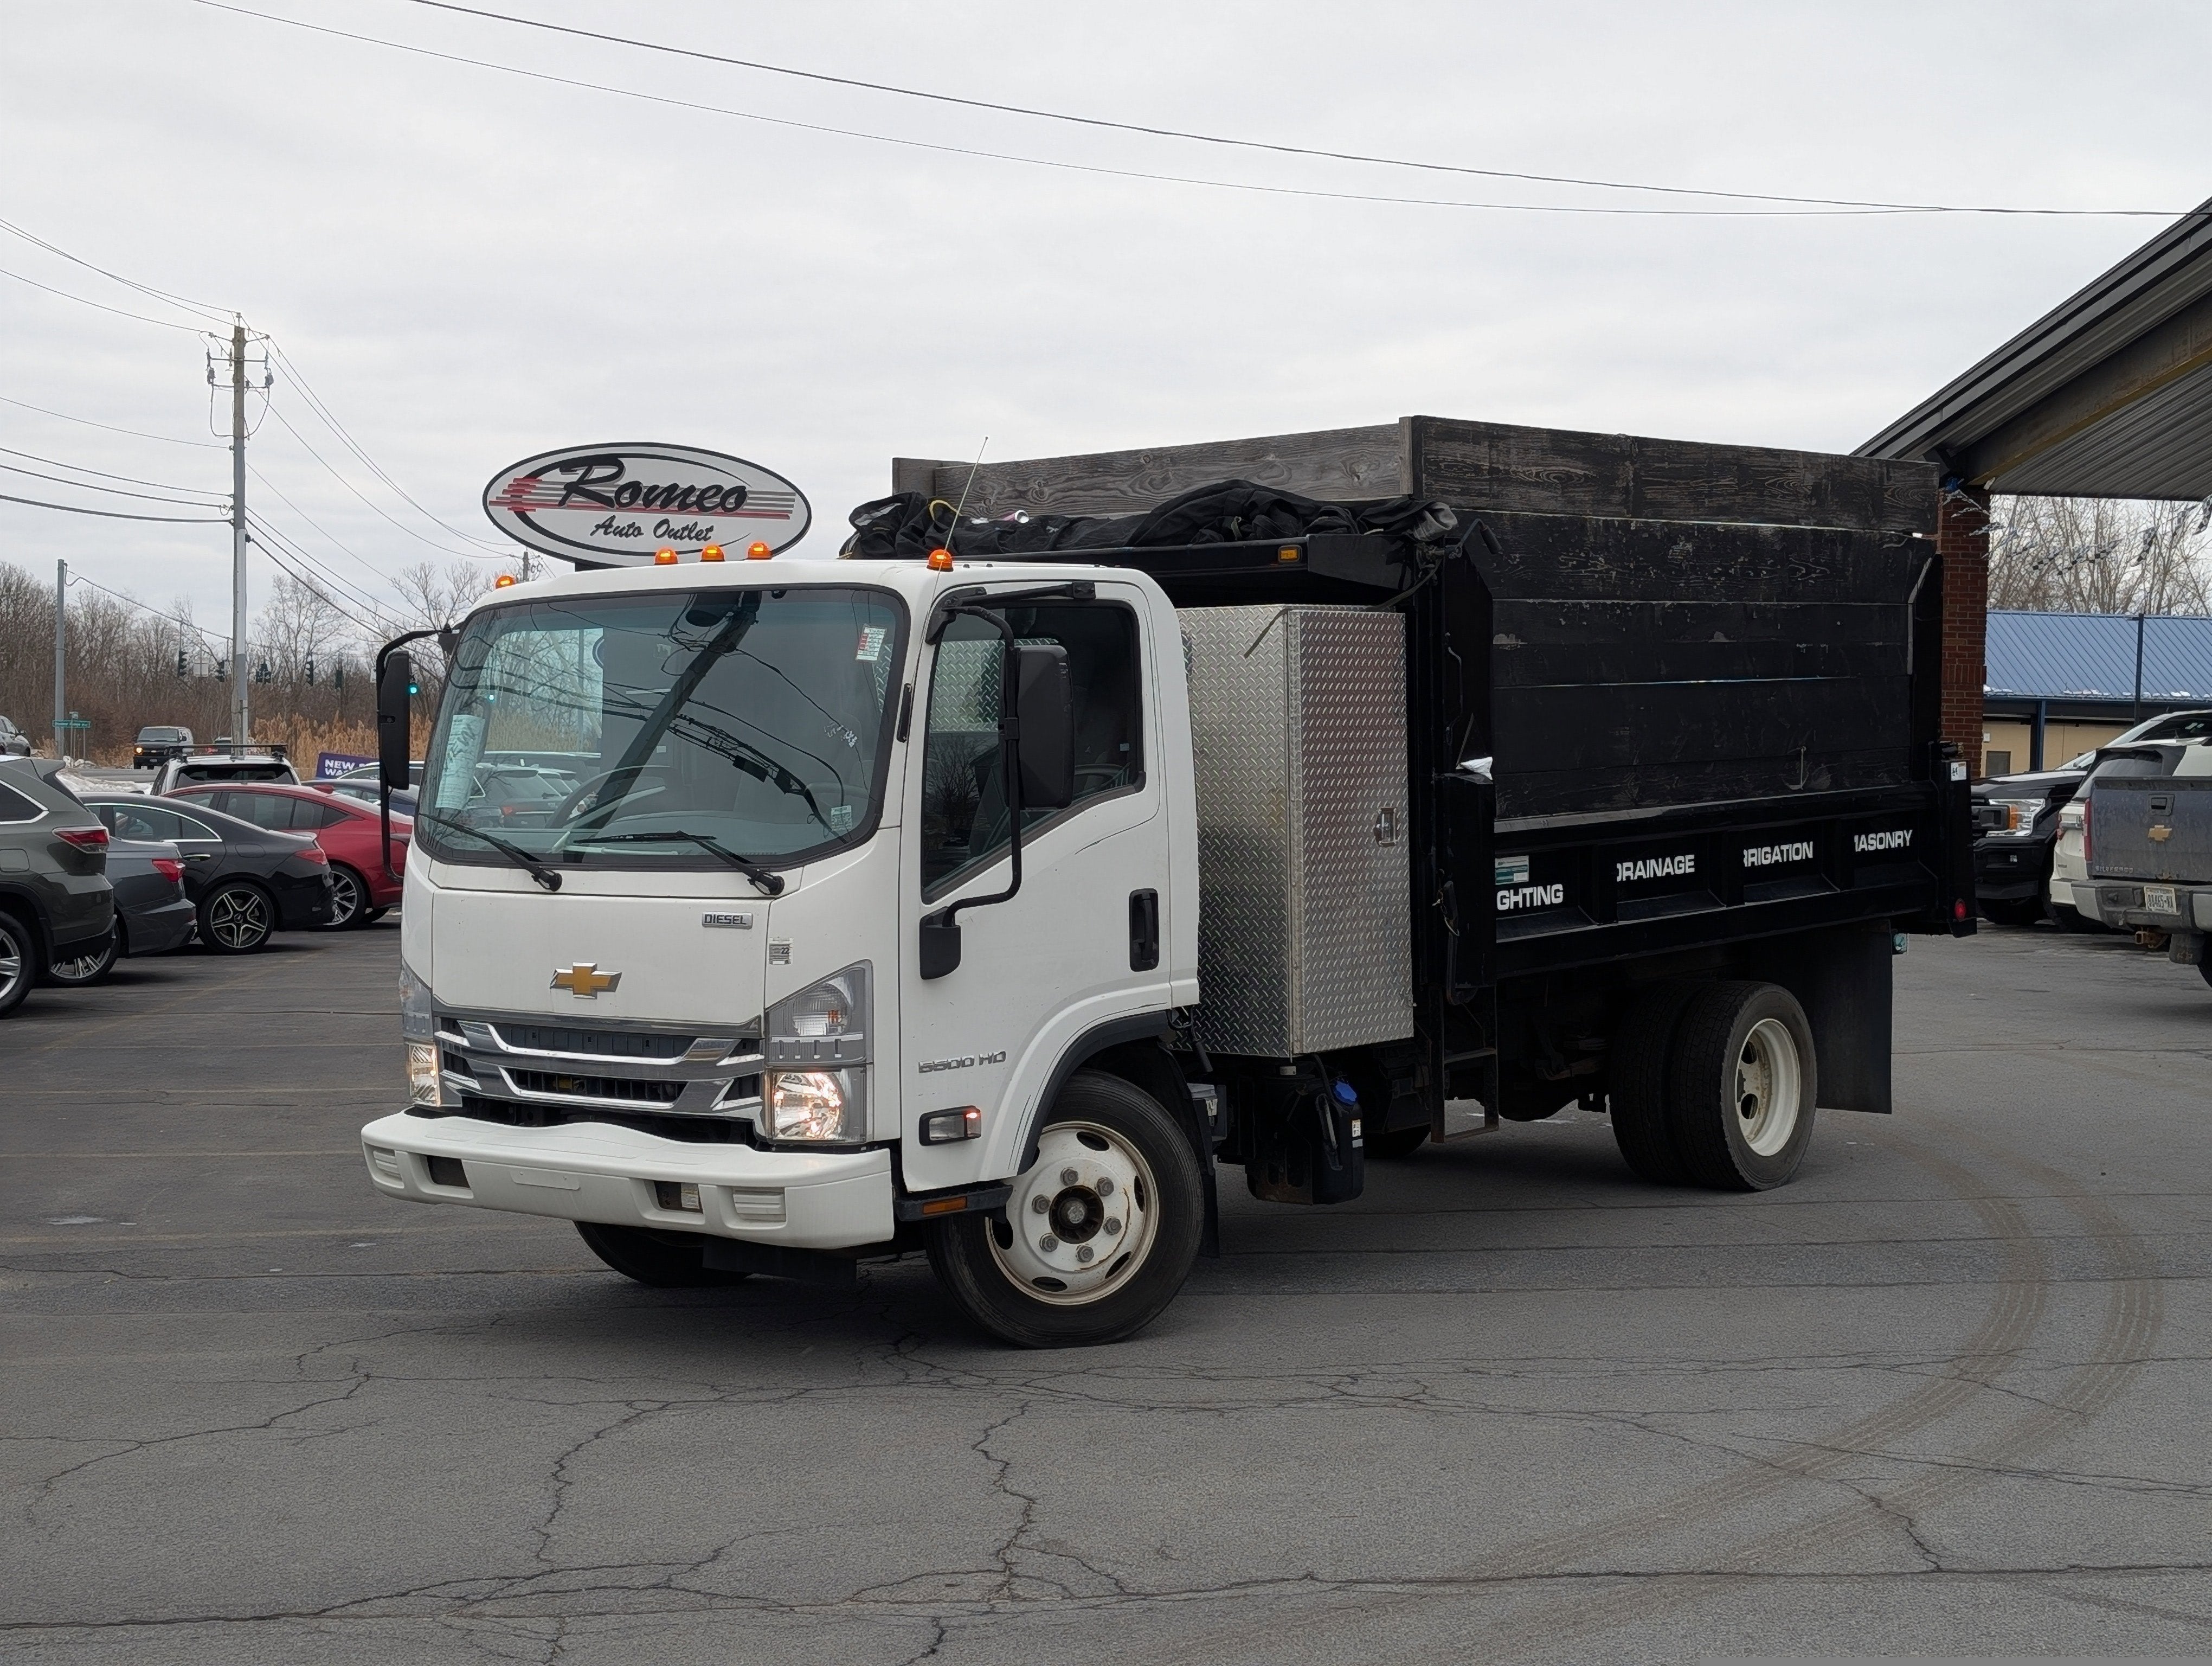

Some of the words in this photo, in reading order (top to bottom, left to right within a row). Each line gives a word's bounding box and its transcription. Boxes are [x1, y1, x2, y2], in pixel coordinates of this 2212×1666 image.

[558, 455, 748, 512] Romeo
[590, 515, 644, 538] Auto
[653, 518, 714, 542] Outlet
[325, 759, 355, 770] NEW
[325, 768, 349, 776] WA
[1496, 884, 1564, 911] GHTING
[704, 914, 747, 925] DIESEL
[979, 1050, 1006, 1066] HD
